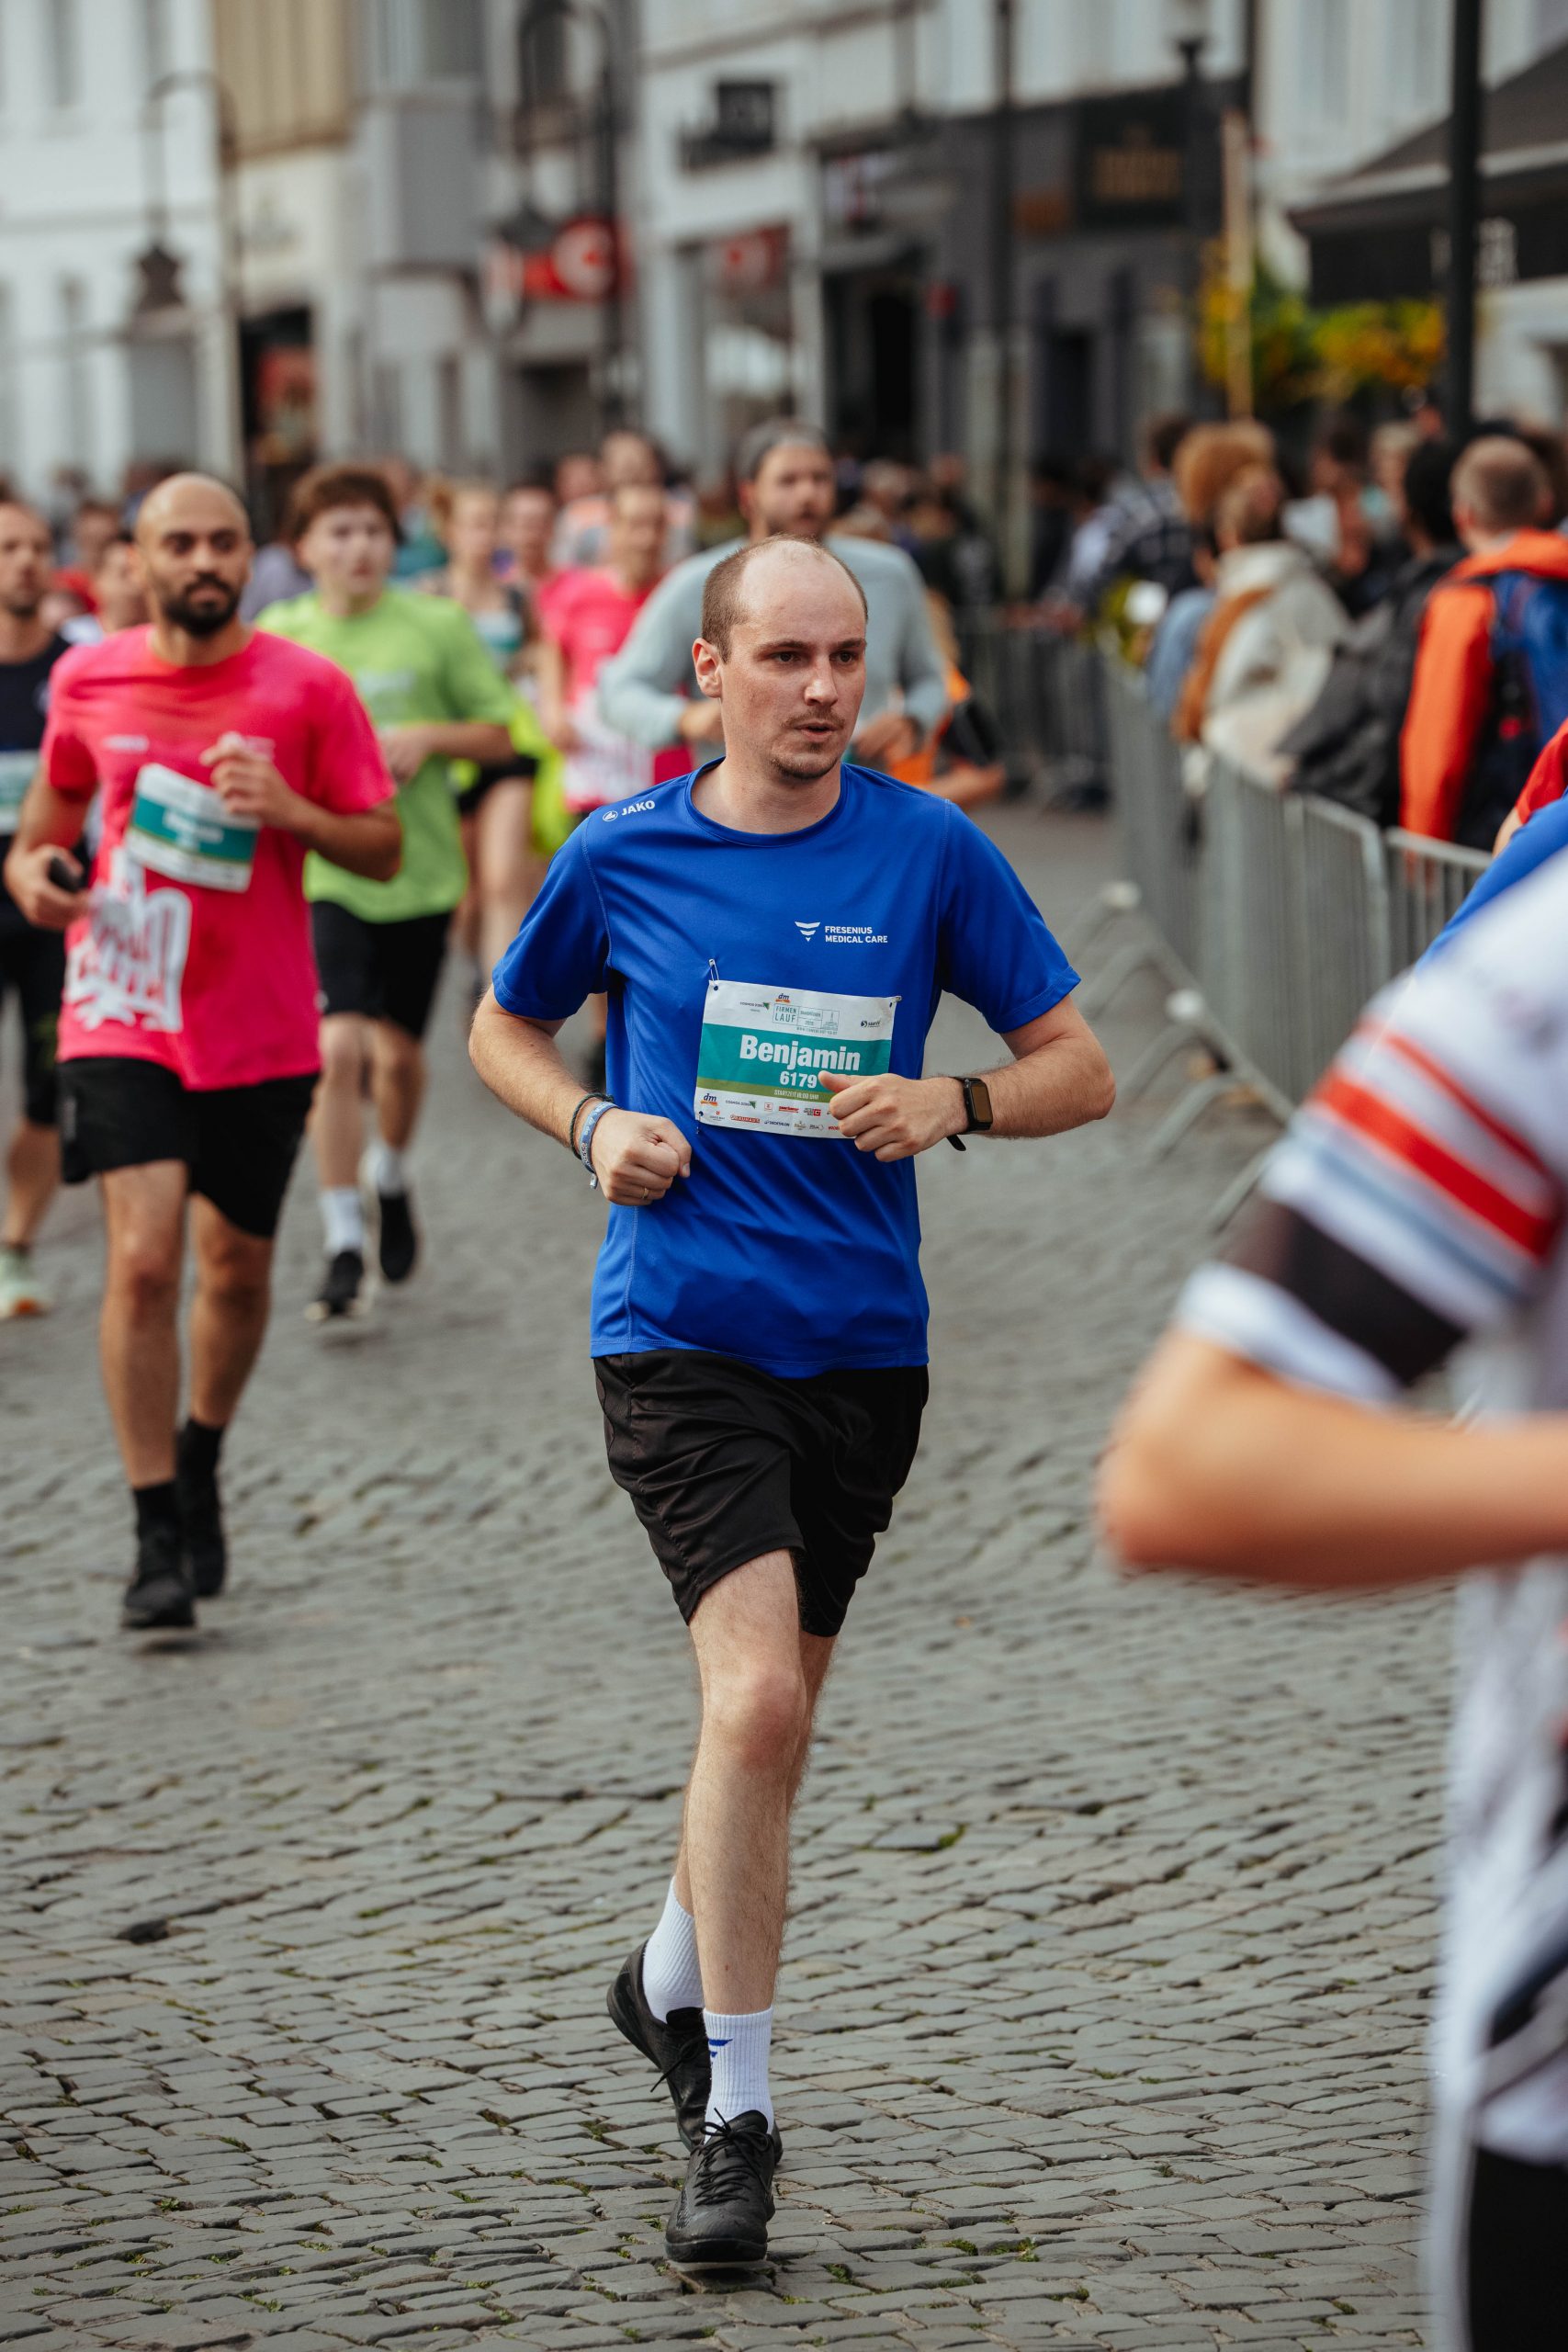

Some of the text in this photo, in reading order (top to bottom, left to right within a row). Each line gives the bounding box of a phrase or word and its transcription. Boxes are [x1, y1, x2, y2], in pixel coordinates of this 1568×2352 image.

[622, 800, 655, 815] JAKO
[825, 926, 873, 934] FRESENIUS
[775, 1012, 795, 1023] LAUF
[739, 1035, 861, 1072] Benjamin
[780, 1071, 818, 1089] 6179
[704, 1093, 716, 1102] dm
